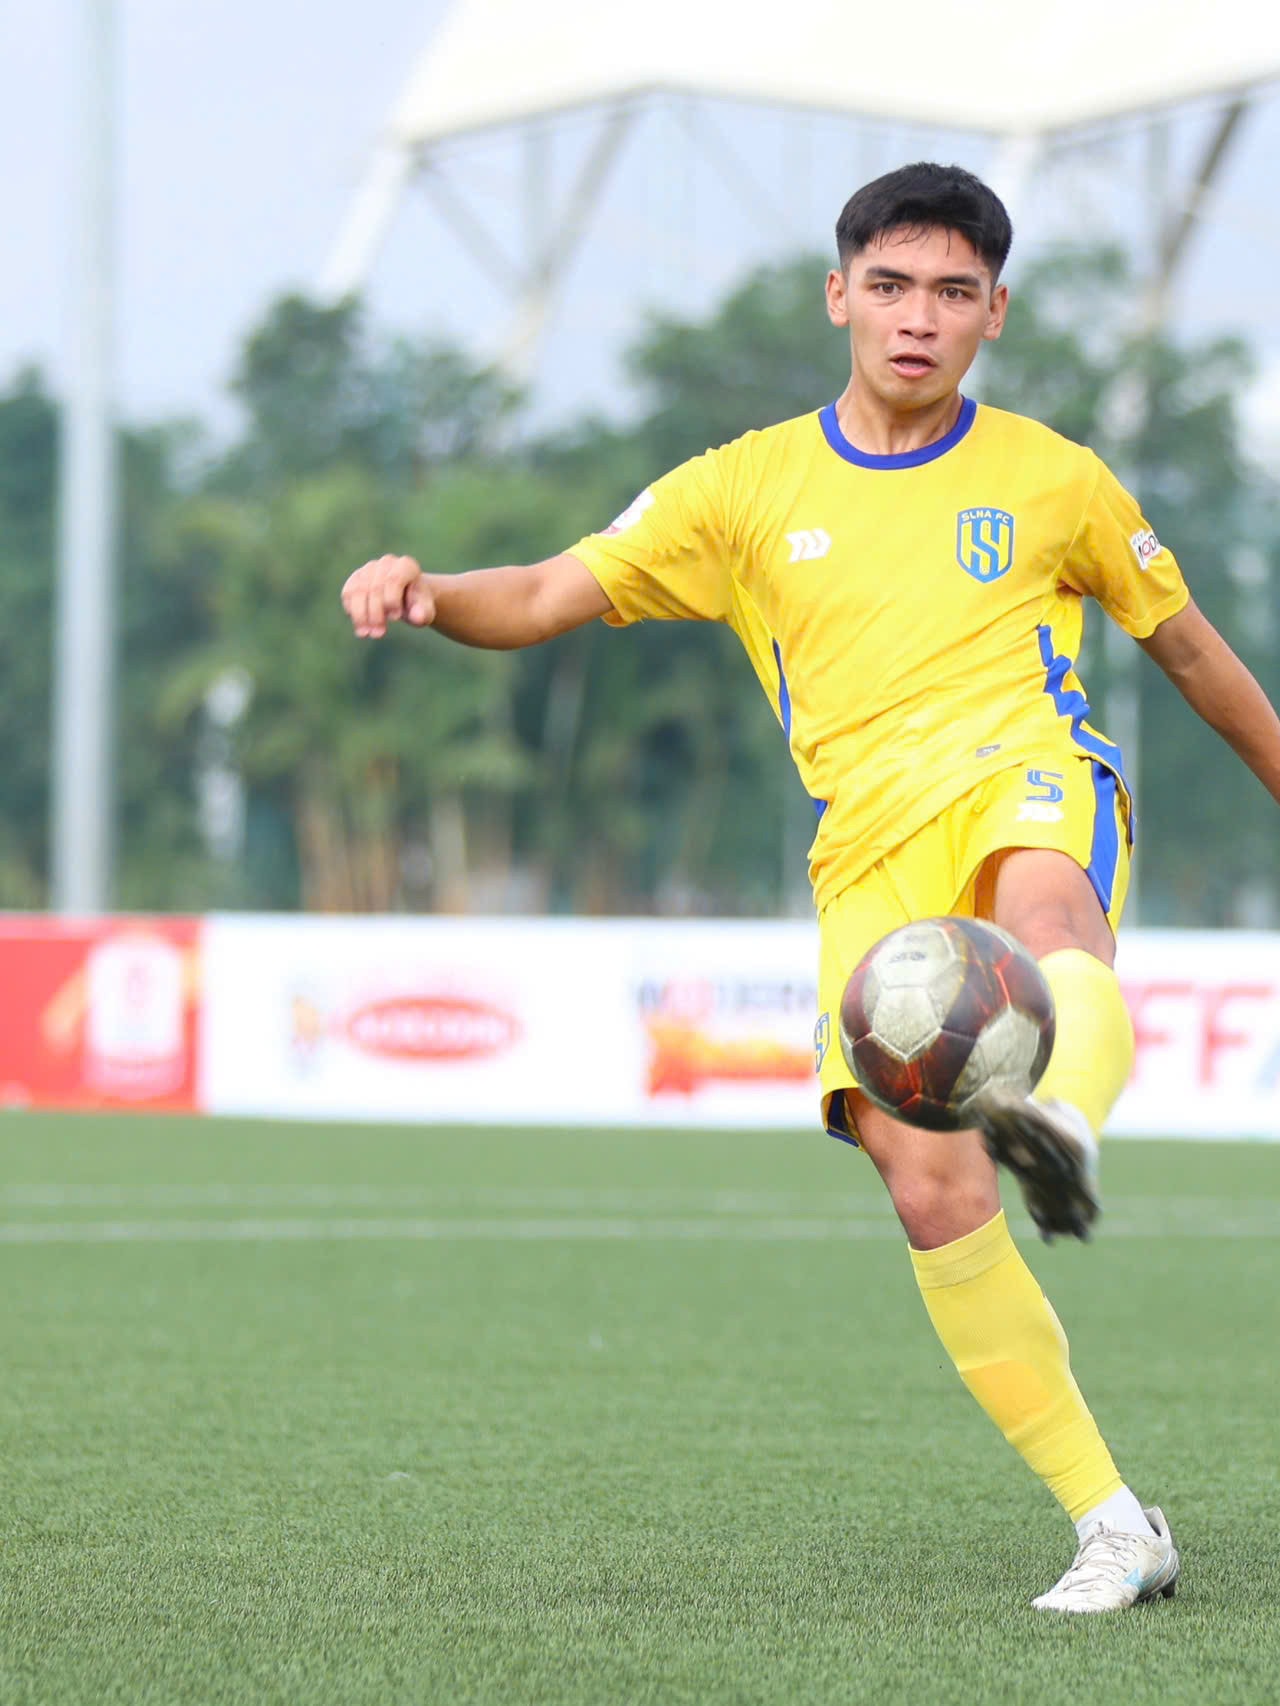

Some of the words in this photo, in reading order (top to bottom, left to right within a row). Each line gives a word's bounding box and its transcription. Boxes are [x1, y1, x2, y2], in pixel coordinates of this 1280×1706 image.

[961, 509, 992, 522] SLNA
[995, 512, 1010, 524] FC
[1025, 768, 1063, 803] 5
